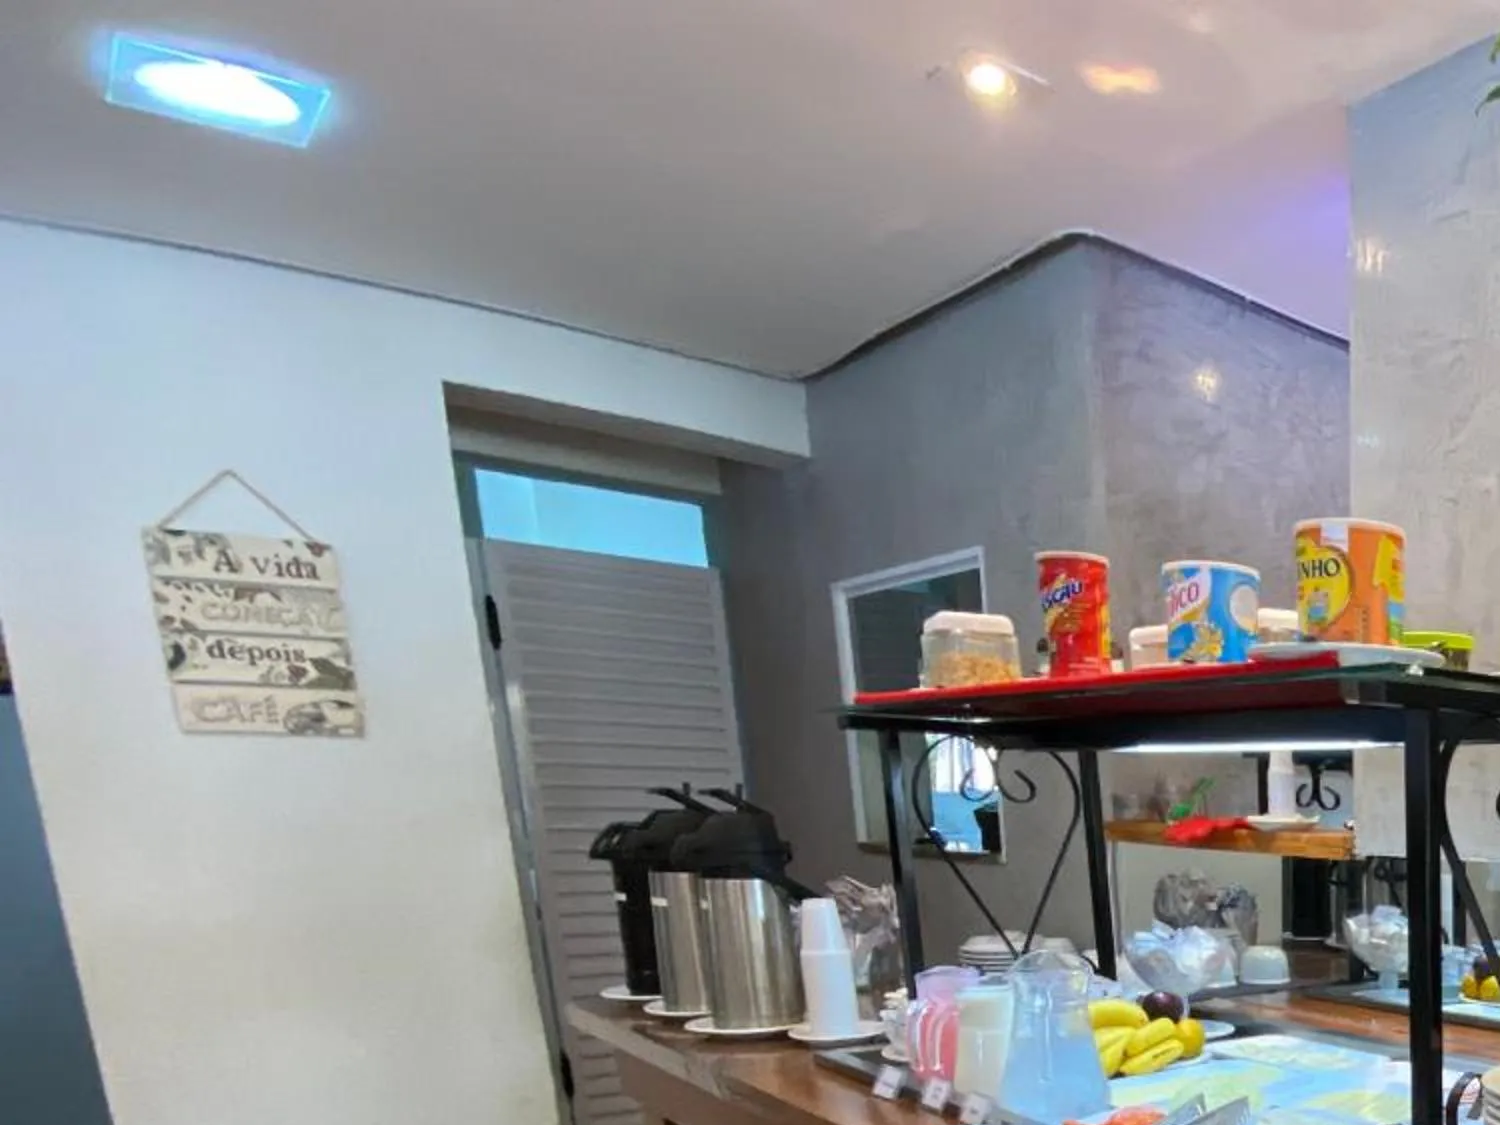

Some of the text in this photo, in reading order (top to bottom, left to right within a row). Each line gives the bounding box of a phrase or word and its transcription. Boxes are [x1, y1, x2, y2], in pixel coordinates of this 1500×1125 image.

[213, 549, 321, 581] A vida
[1298, 557, 1341, 579] NHO
[206, 640, 307, 666] depois
[194, 695, 279, 723] CAFÉ
